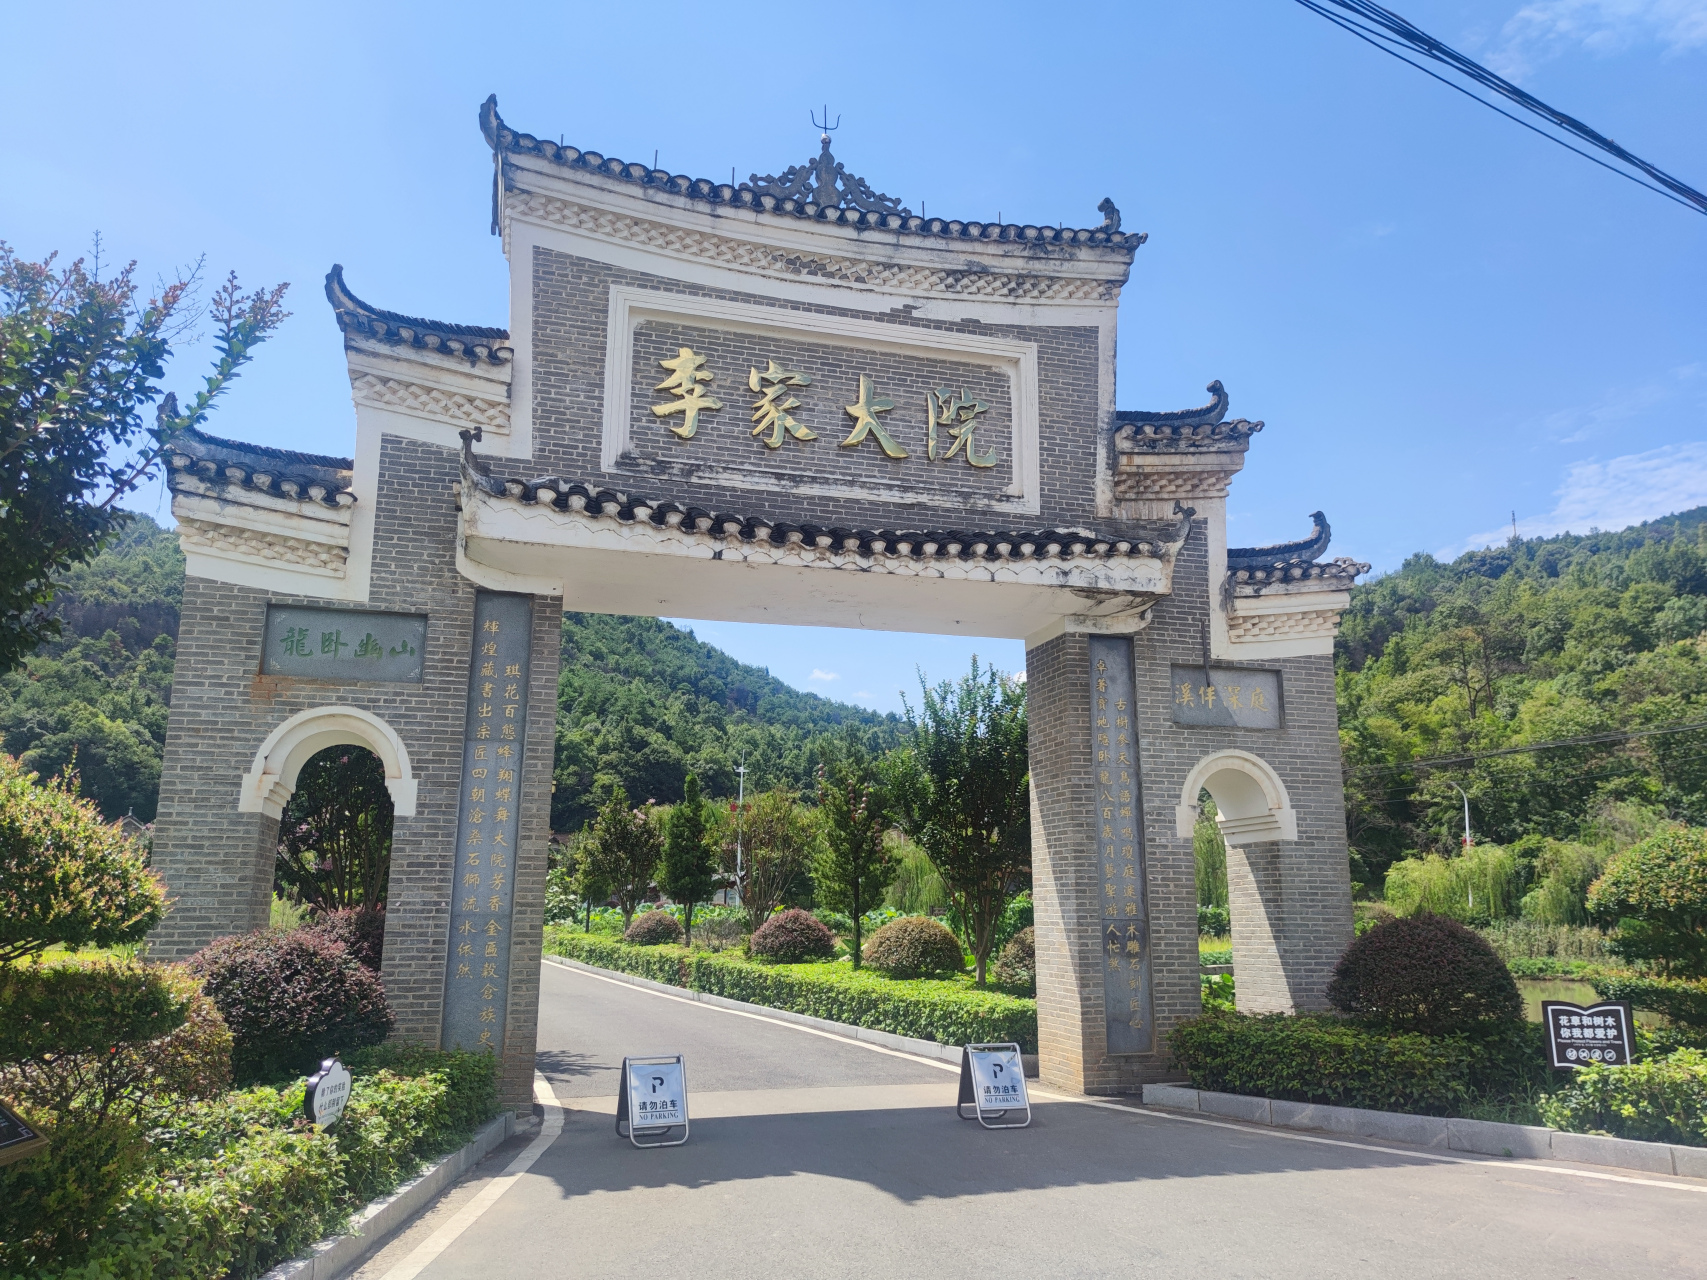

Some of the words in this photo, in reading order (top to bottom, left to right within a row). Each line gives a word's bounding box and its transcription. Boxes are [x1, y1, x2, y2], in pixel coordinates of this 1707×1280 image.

[650, 347, 998, 468] 李家大院
[1558, 1015, 1616, 1026] 花草和树木
[1560, 1027, 1618, 1039] 你我都爱护
[983, 1085, 1019, 1095] 请勿泊车
[638, 1099, 678, 1111] 请勿泊车
[650, 1111, 679, 1120] PARKING
